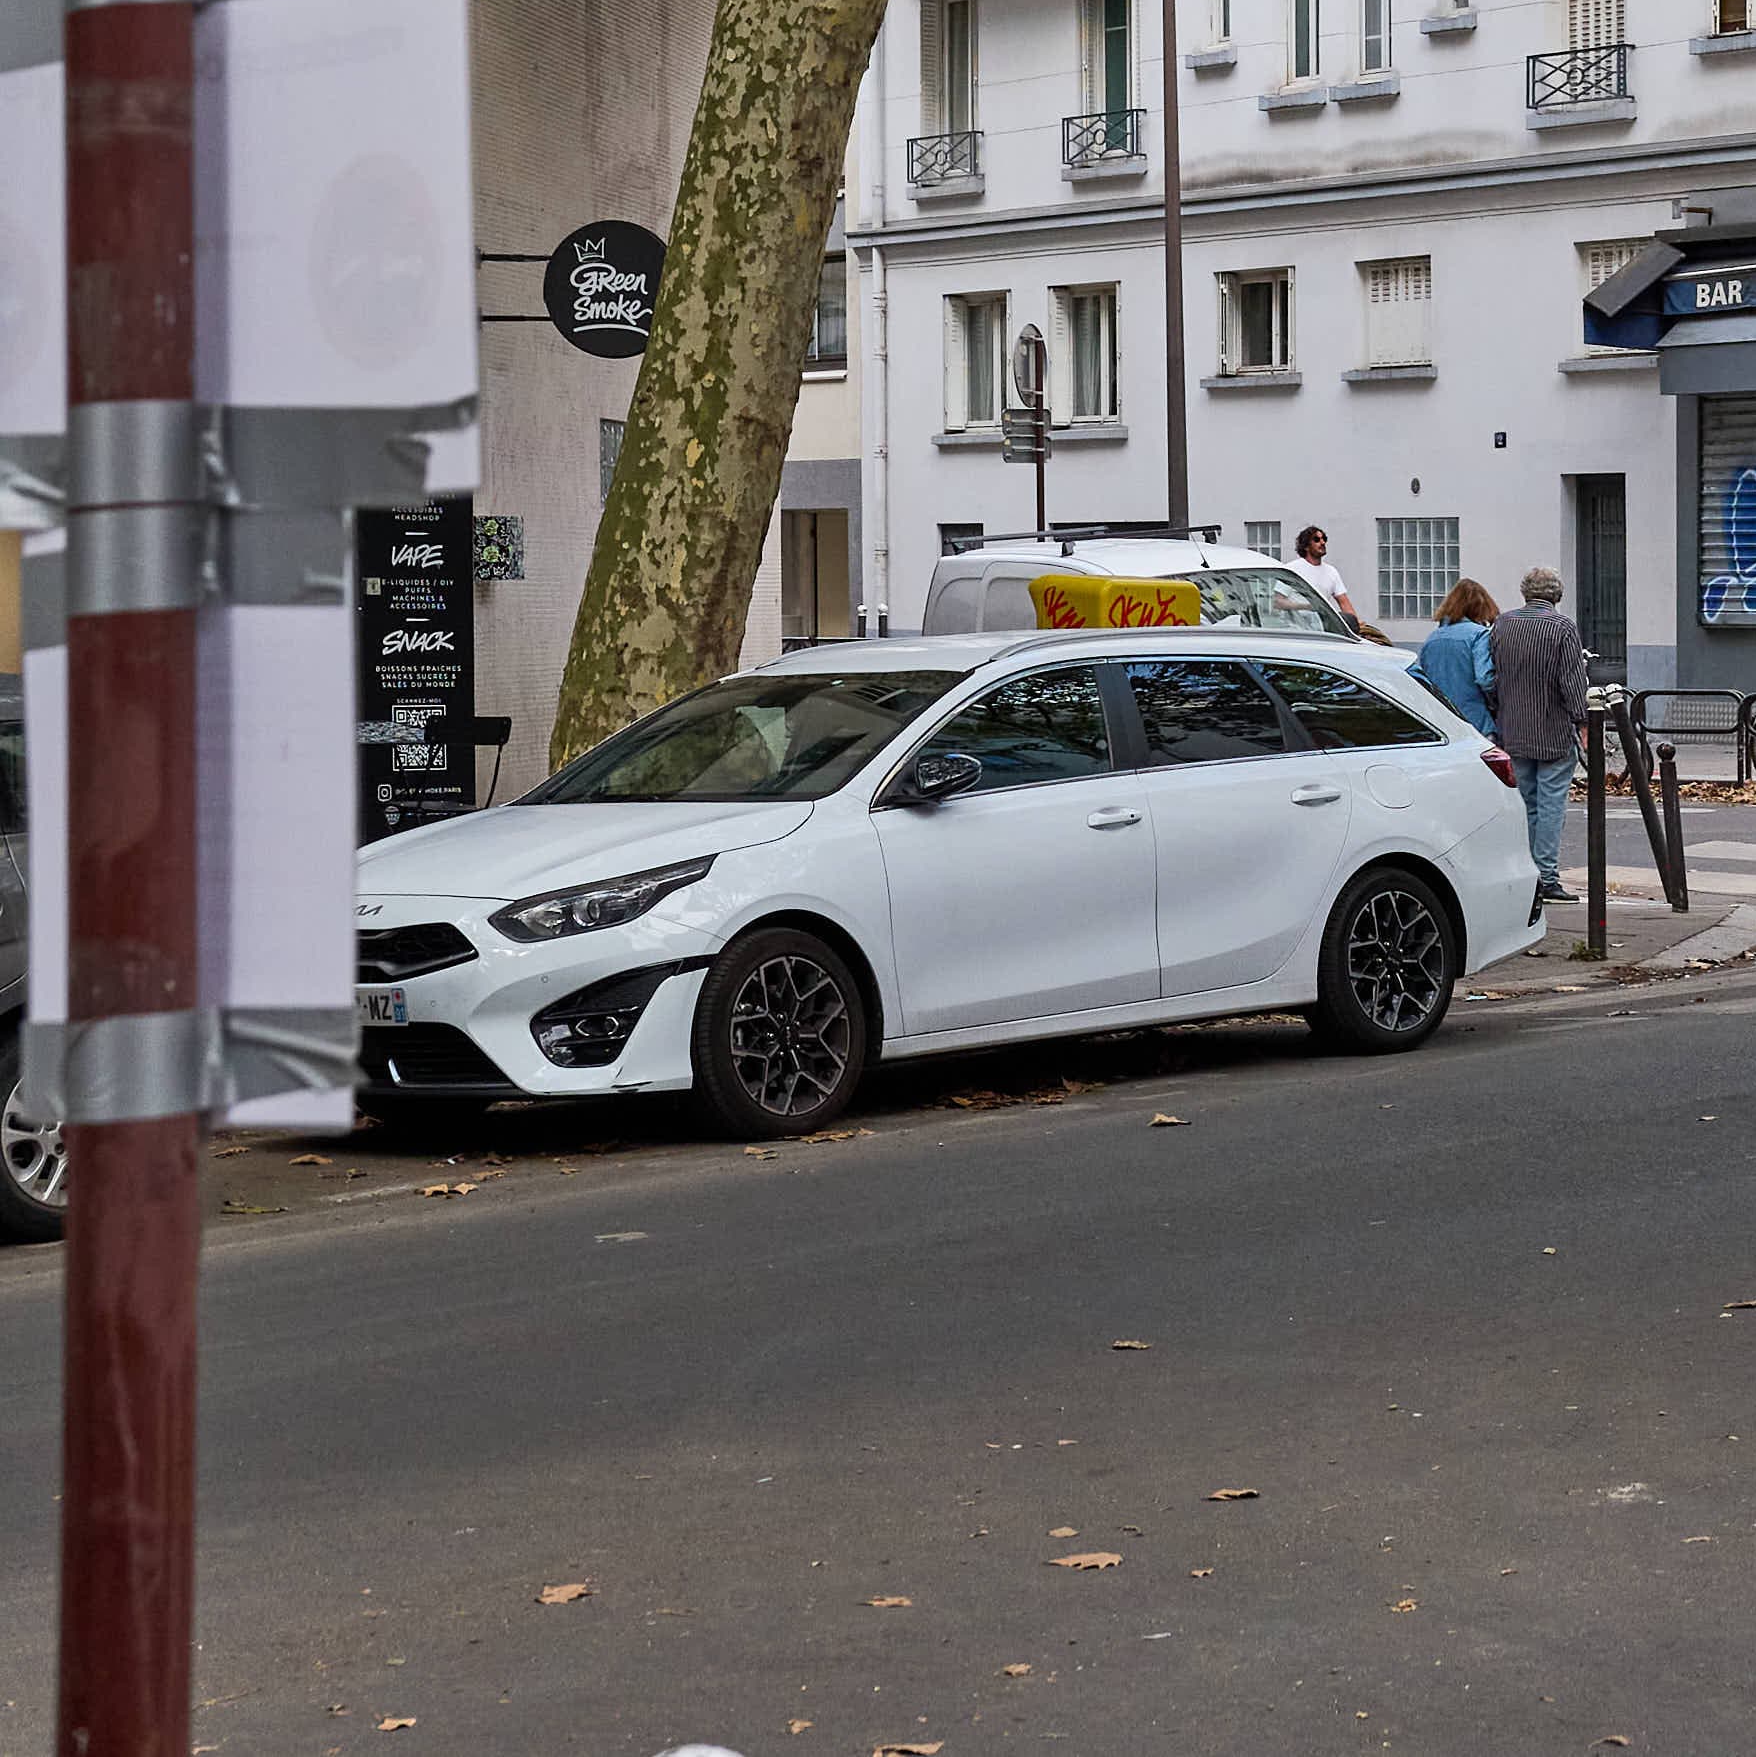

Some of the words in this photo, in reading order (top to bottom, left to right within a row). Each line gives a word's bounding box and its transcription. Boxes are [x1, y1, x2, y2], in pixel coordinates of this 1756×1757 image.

[1695, 279, 1742, 308] BAR
[391, 543, 444, 568] VAPE
[392, 594, 435, 602] MACHINES
[382, 629, 455, 656] SNACK
[375, 665, 418, 673] BOISSONS
[380, 673, 413, 681] SNACKS
